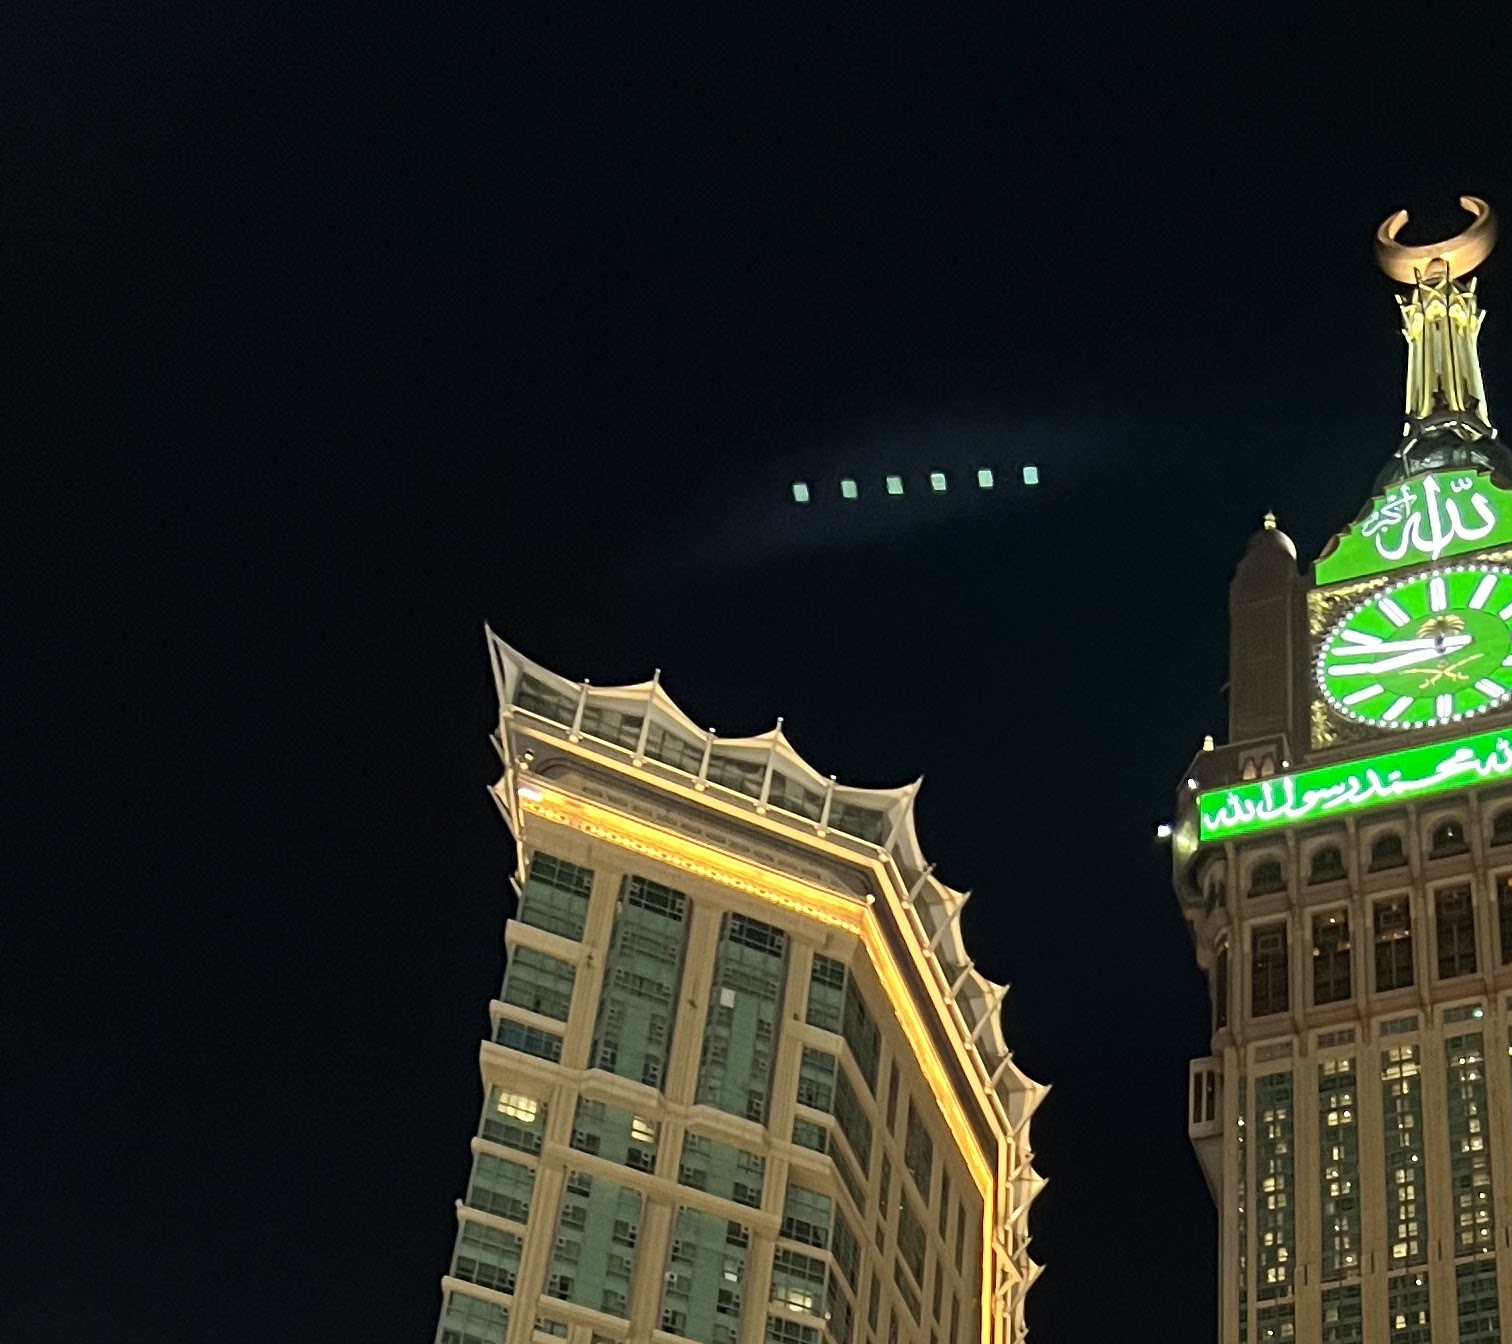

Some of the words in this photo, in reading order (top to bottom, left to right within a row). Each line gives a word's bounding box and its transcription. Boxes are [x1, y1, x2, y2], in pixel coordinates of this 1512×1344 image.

[1257, 776, 1361, 819] رسول
[1351, 748, 1482, 804] محمد
[1203, 783, 1274, 830] الله
